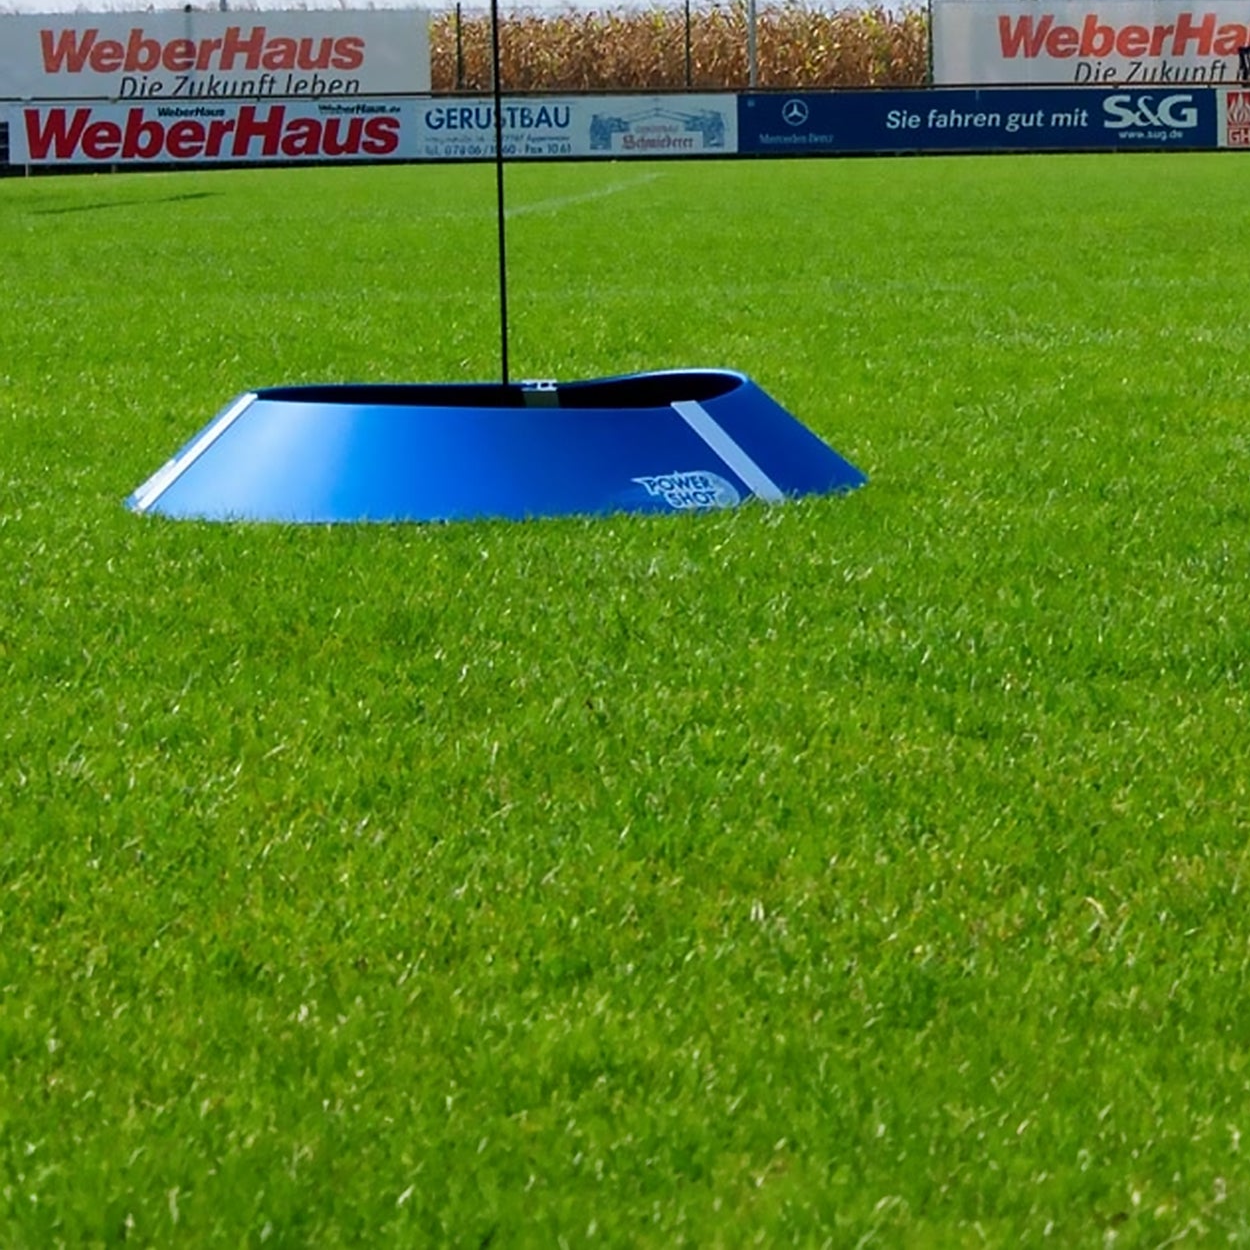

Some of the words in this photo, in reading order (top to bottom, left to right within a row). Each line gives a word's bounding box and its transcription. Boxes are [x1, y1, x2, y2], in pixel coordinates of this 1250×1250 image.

[39, 26, 366, 73] WeberHaus
[1074, 62, 1116, 82] Die
[1126, 59, 1229, 82] Zukunft
[118, 75, 163, 97] Die
[172, 73, 277, 97] Zukunft
[285, 73, 361, 95] leben
[886, 110, 921, 129] Sie
[927, 109, 1001, 128] fahren
[1006, 111, 1045, 133] gut
[1051, 109, 1088, 128] mit
[1103, 94, 1198, 129] S&G
[23, 104, 402, 161] WeberHaus
[644, 475, 713, 492] POWER
[667, 490, 717, 506] SHOT
